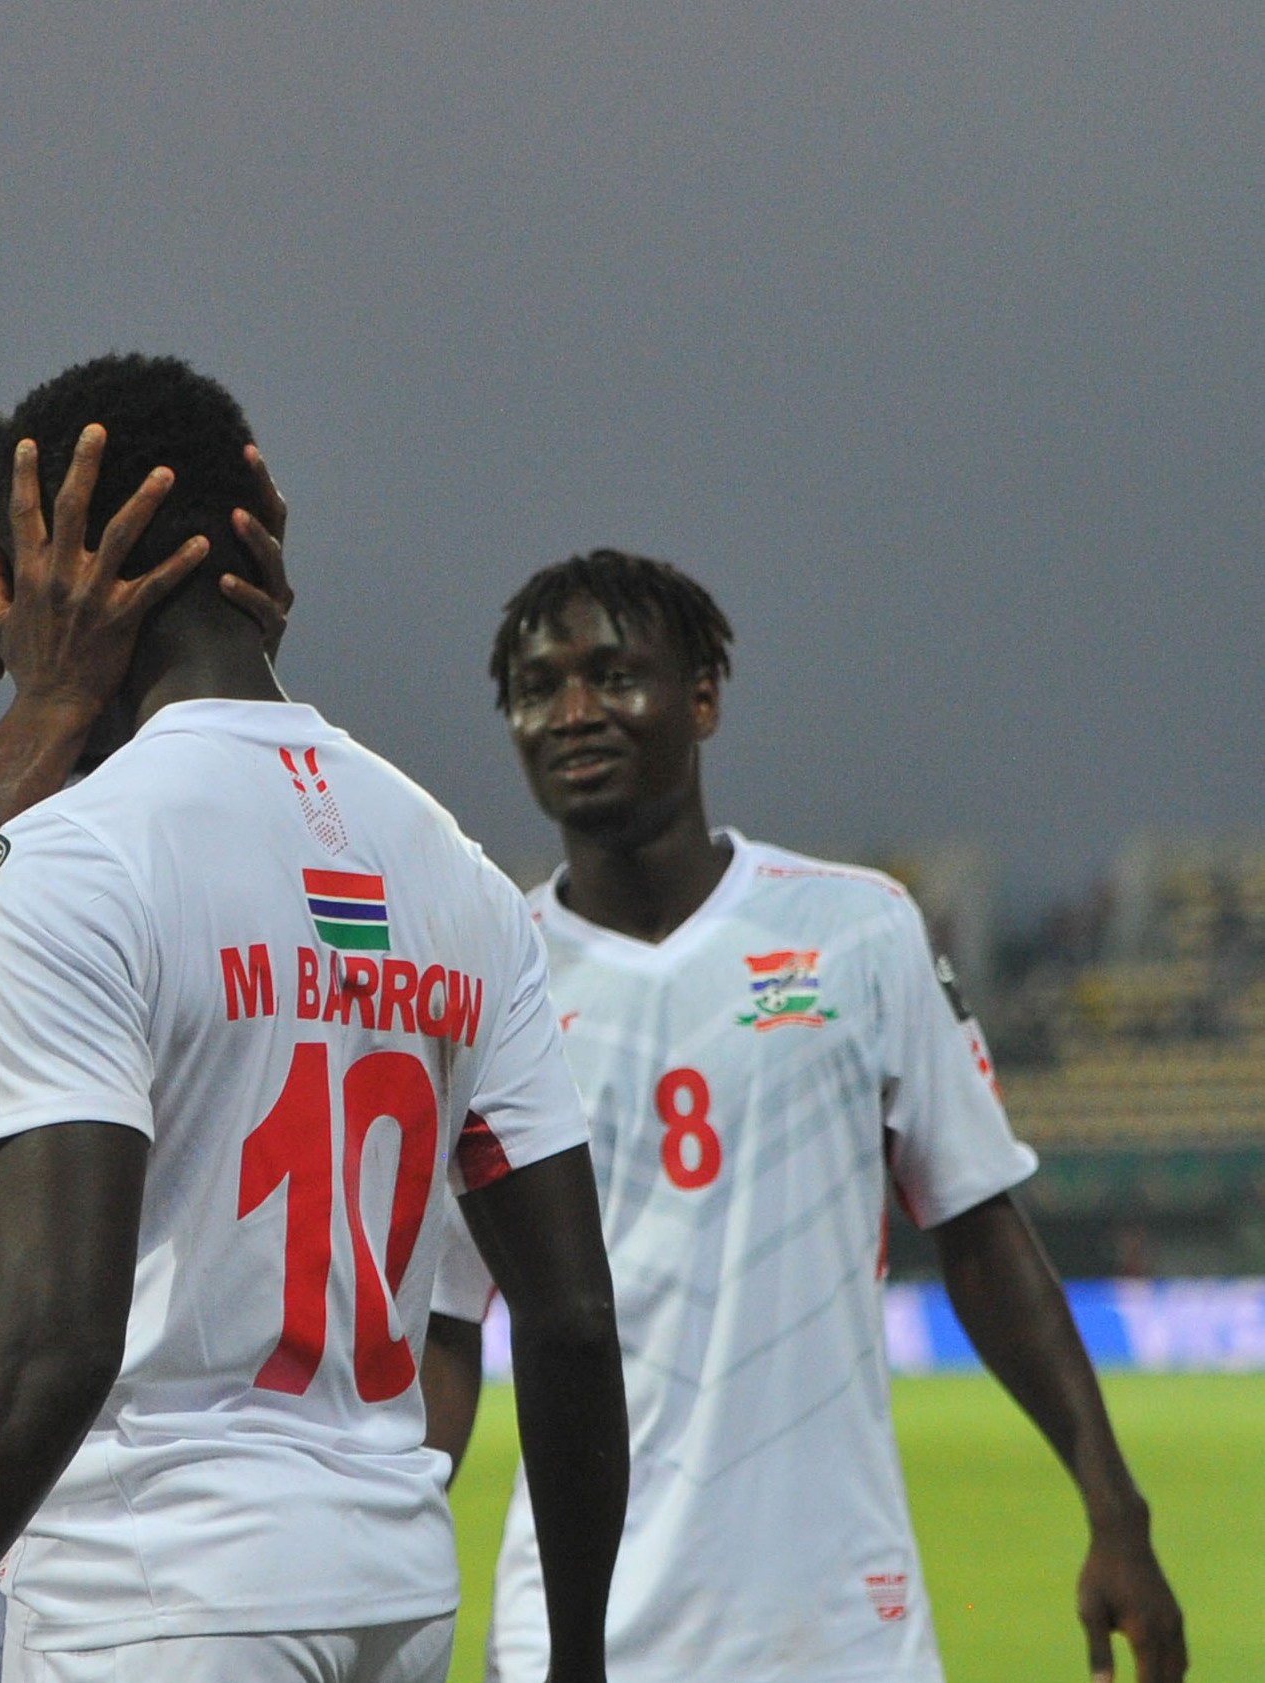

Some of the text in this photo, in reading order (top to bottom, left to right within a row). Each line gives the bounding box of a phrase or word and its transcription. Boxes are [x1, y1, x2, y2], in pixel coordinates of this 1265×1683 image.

[220, 943, 482, 1047] M BARROW
[656, 1067, 721, 1189] 8
[237, 1042, 438, 1403] 10
